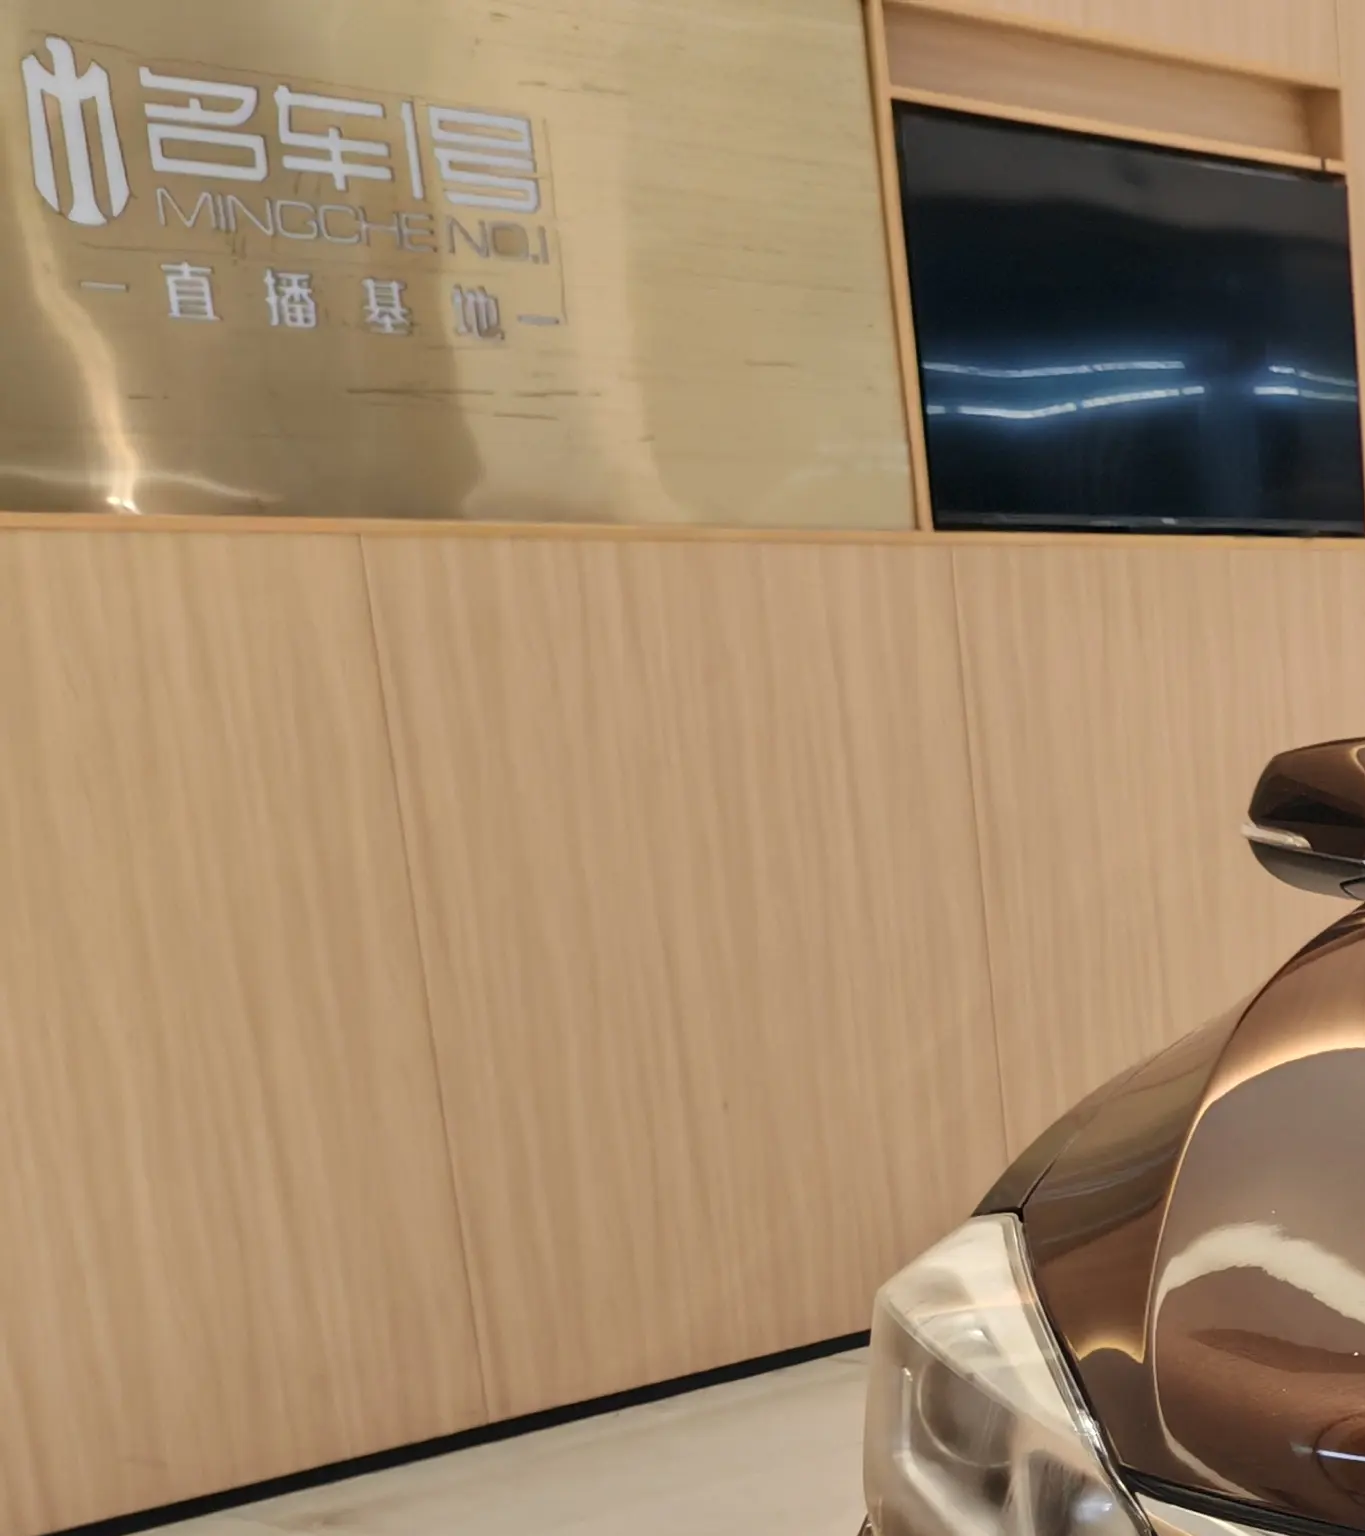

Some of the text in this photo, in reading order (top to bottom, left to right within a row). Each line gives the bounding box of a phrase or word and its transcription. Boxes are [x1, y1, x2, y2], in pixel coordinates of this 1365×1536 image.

[156, 187, 438, 253] MINGCHE
[160, 261, 506, 340] 直播基地
